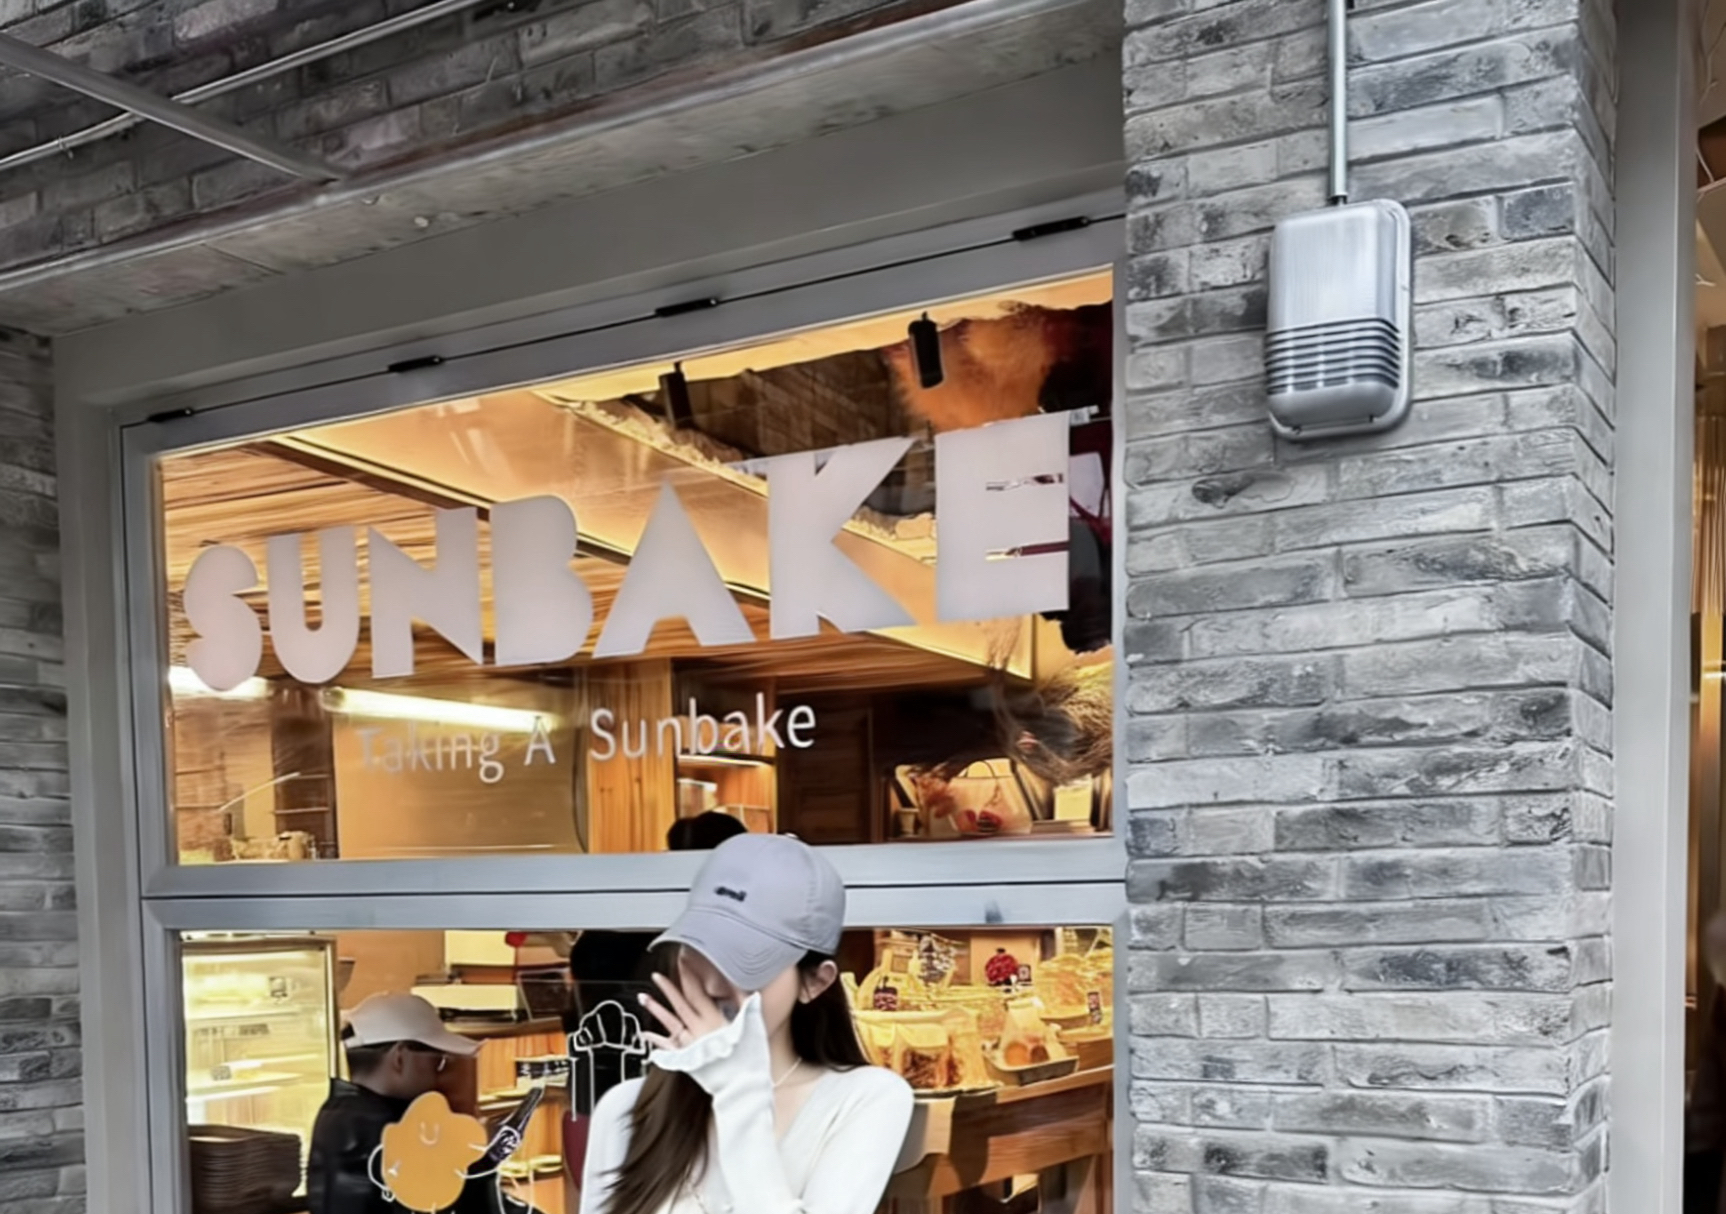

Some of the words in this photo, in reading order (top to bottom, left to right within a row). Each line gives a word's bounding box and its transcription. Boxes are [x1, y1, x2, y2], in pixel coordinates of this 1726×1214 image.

[183, 410, 1070, 692] SUNBAKE
[356, 719, 505, 784] Taking
[523, 714, 557, 766] A
[589, 691, 817, 762] Sunbake
